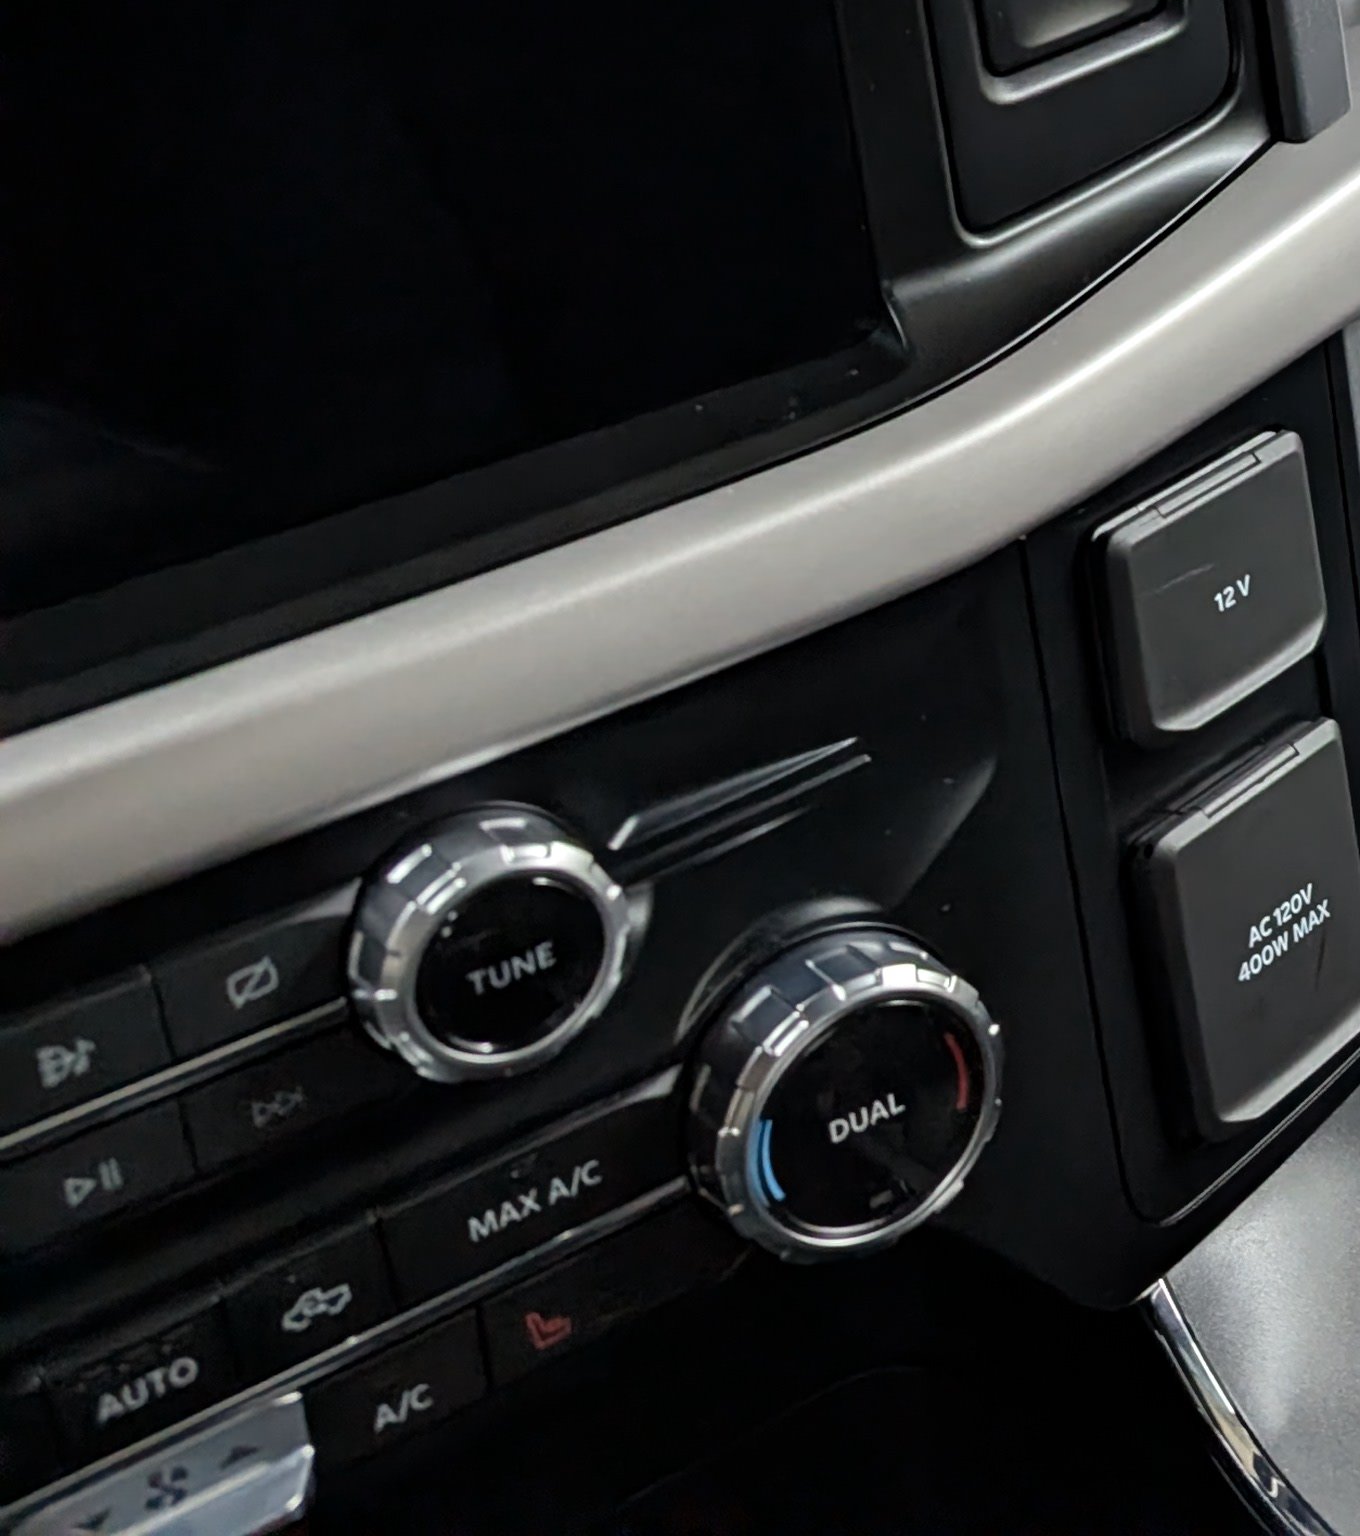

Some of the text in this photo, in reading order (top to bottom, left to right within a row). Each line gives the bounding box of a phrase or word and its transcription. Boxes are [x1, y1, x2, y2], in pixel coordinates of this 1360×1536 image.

[1238, 899, 1331, 982] 400W MAX
[1248, 882, 1313, 948] AC 120V
[465, 939, 557, 998] TUNE
[827, 1092, 907, 1145] DUAL
[466, 1157, 603, 1243] MAX A/C
[94, 1356, 199, 1424] AUTO
[372, 1382, 434, 1434] A/C
